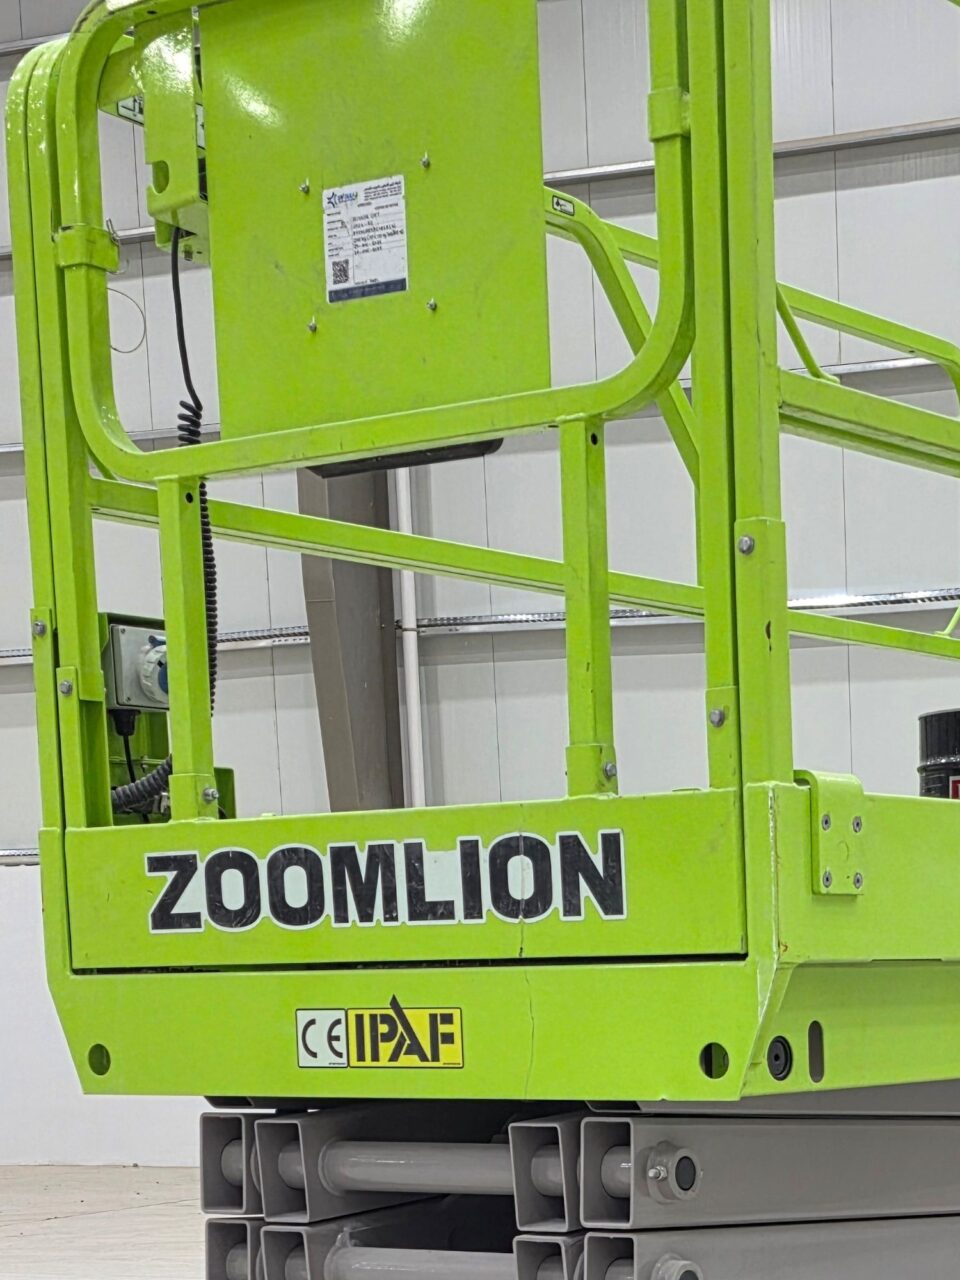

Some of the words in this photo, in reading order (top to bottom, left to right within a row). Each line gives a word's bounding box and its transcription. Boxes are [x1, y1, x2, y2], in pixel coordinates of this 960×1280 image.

[145, 829, 625, 931] ZOOMLION
[301, 1017, 344, 1059] CE
[354, 993, 455, 1063] IPAF
